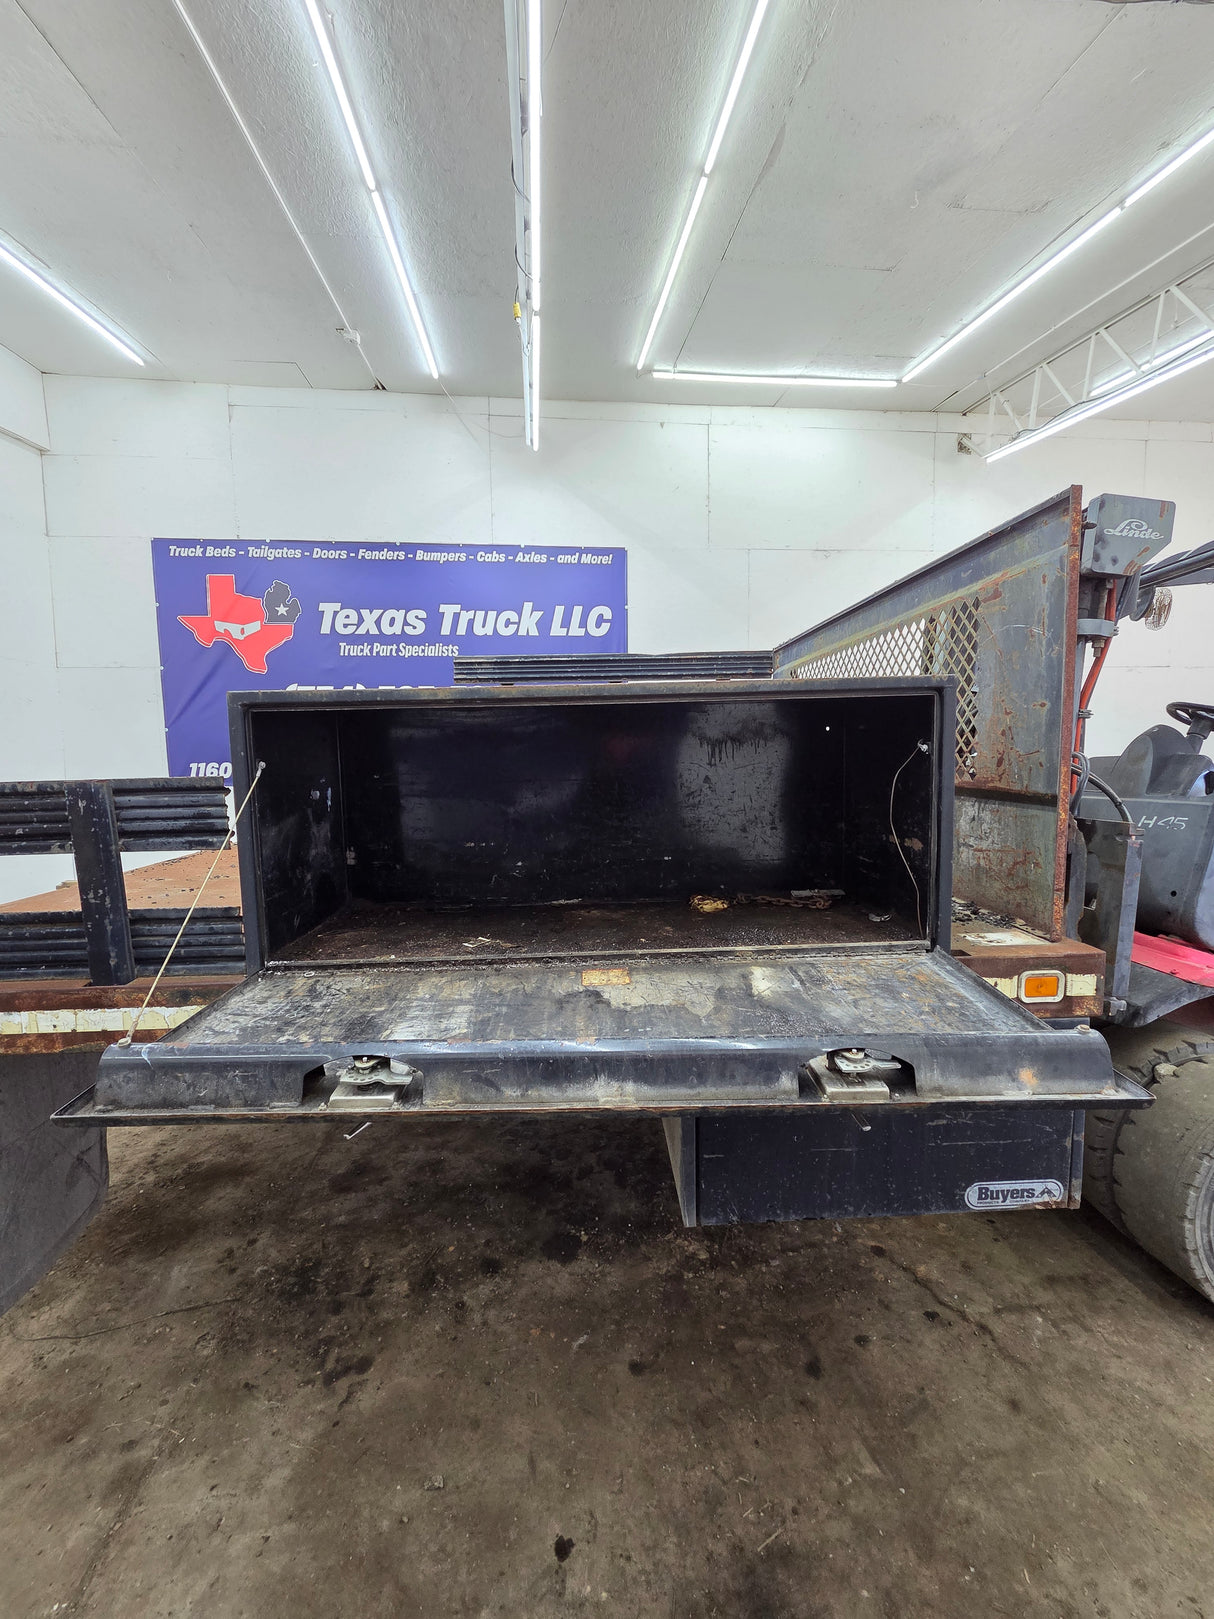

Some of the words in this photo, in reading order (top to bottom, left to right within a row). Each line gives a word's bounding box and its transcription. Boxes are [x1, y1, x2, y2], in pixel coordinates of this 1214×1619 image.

[1103, 518, 1164, 540] Linde
[168, 545, 203, 557] Truck
[205, 546, 236, 558] Beds
[247, 546, 302, 561] Tailgates
[312, 547, 348, 560] Doors
[357, 548, 406, 561] Fenders
[415, 549, 467, 564] Bumpers
[476, 550, 506, 563] Cabs
[515, 551, 548, 563] Axles
[556, 552, 578, 564] and
[580, 552, 613, 565] More!
[318, 602, 428, 636] Texas
[438, 601, 545, 637] Truck
[549, 605, 613, 637] LLC
[338, 642, 371, 657] Truck
[372, 642, 397, 657] Part
[398, 642, 459, 658] Specialists
[189, 761, 232, 779] 1160
[976, 1186, 1036, 1204] Buyers
